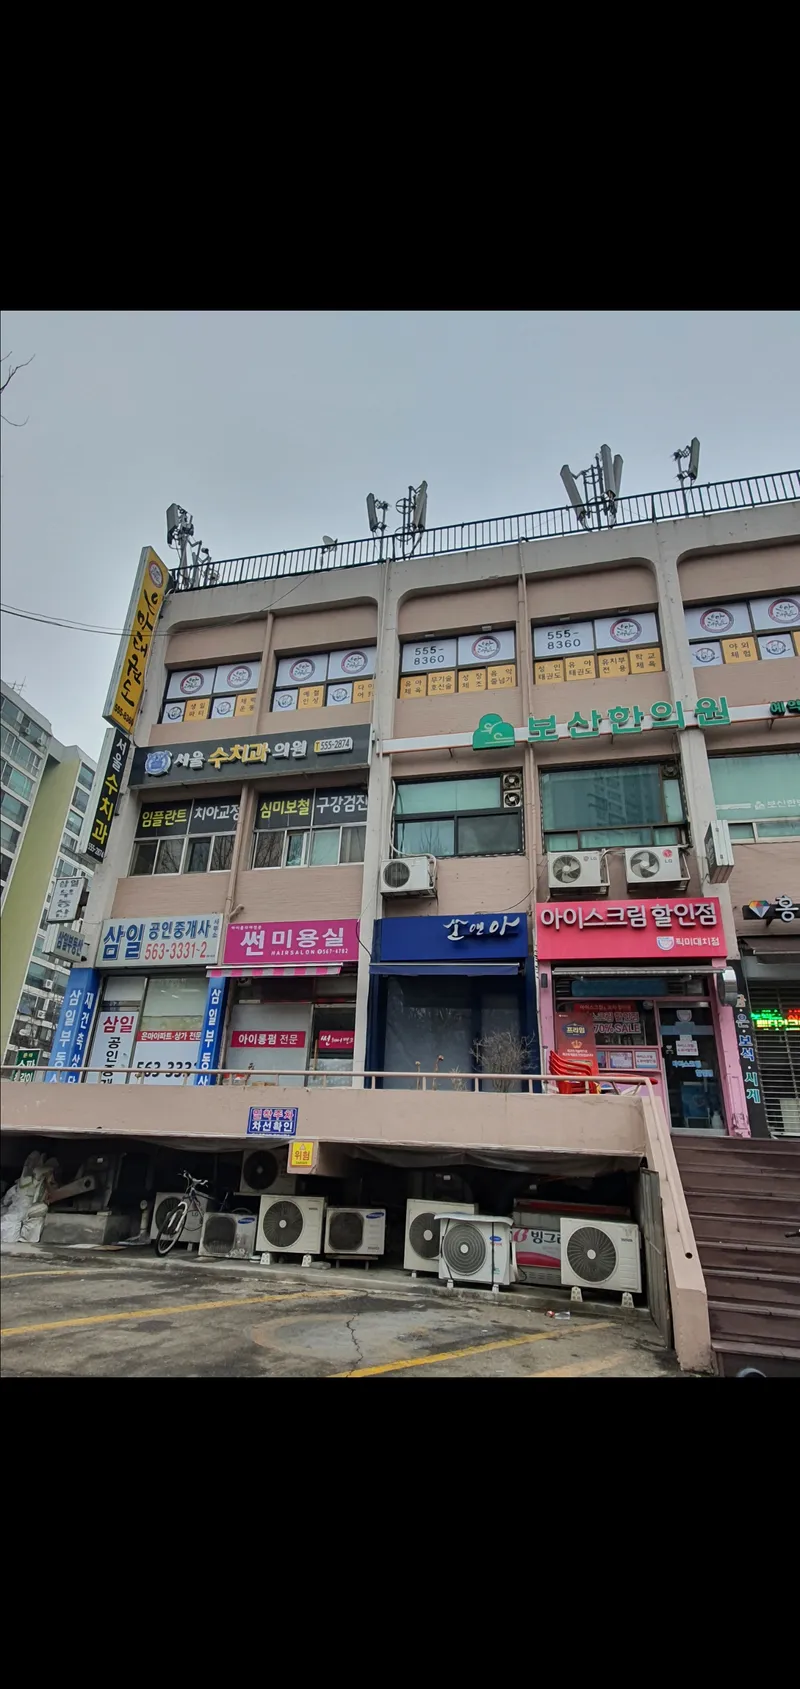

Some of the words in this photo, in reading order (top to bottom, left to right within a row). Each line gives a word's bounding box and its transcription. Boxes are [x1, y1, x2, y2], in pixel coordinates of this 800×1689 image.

[547, 629, 579, 640] 555-
[547, 638, 581, 650] 8360
[413, 655, 445, 665] 8360
[415, 646, 444, 656] 555-
[527, 696, 732, 743] 보산한의원
[320, 738, 350, 752] 555-2874
[112, 738, 127, 772] 서울
[173, 750, 206, 770] 서울
[207, 742, 270, 770] 수치과
[271, 740, 308, 759] 의원
[92, 774, 118, 845] 수치과
[194, 804, 240, 821] 치아교정
[260, 798, 310, 819] 심미보철
[316, 795, 368, 814] 구강검진
[142, 808, 187, 828] 임플란트
[540, 904, 647, 931] 아이스크림
[651, 902, 718, 928] 할인점
[149, 920, 211, 940] 공인중개사
[103, 924, 144, 960] 삼일
[240, 930, 265, 956] 썬
[272, 928, 344, 948] 미용실
[104, 1016, 134, 1033] 삼일
[614, 1023, 642, 1034] SALE
[50, 990, 81, 1082] 삼일부동
[238, 1034, 276, 1045] 아이롱펌
[280, 1034, 298, 1044] 전문
[252, 1121, 292, 1132] 차선확인
[294, 1150, 310, 1160] 위험
